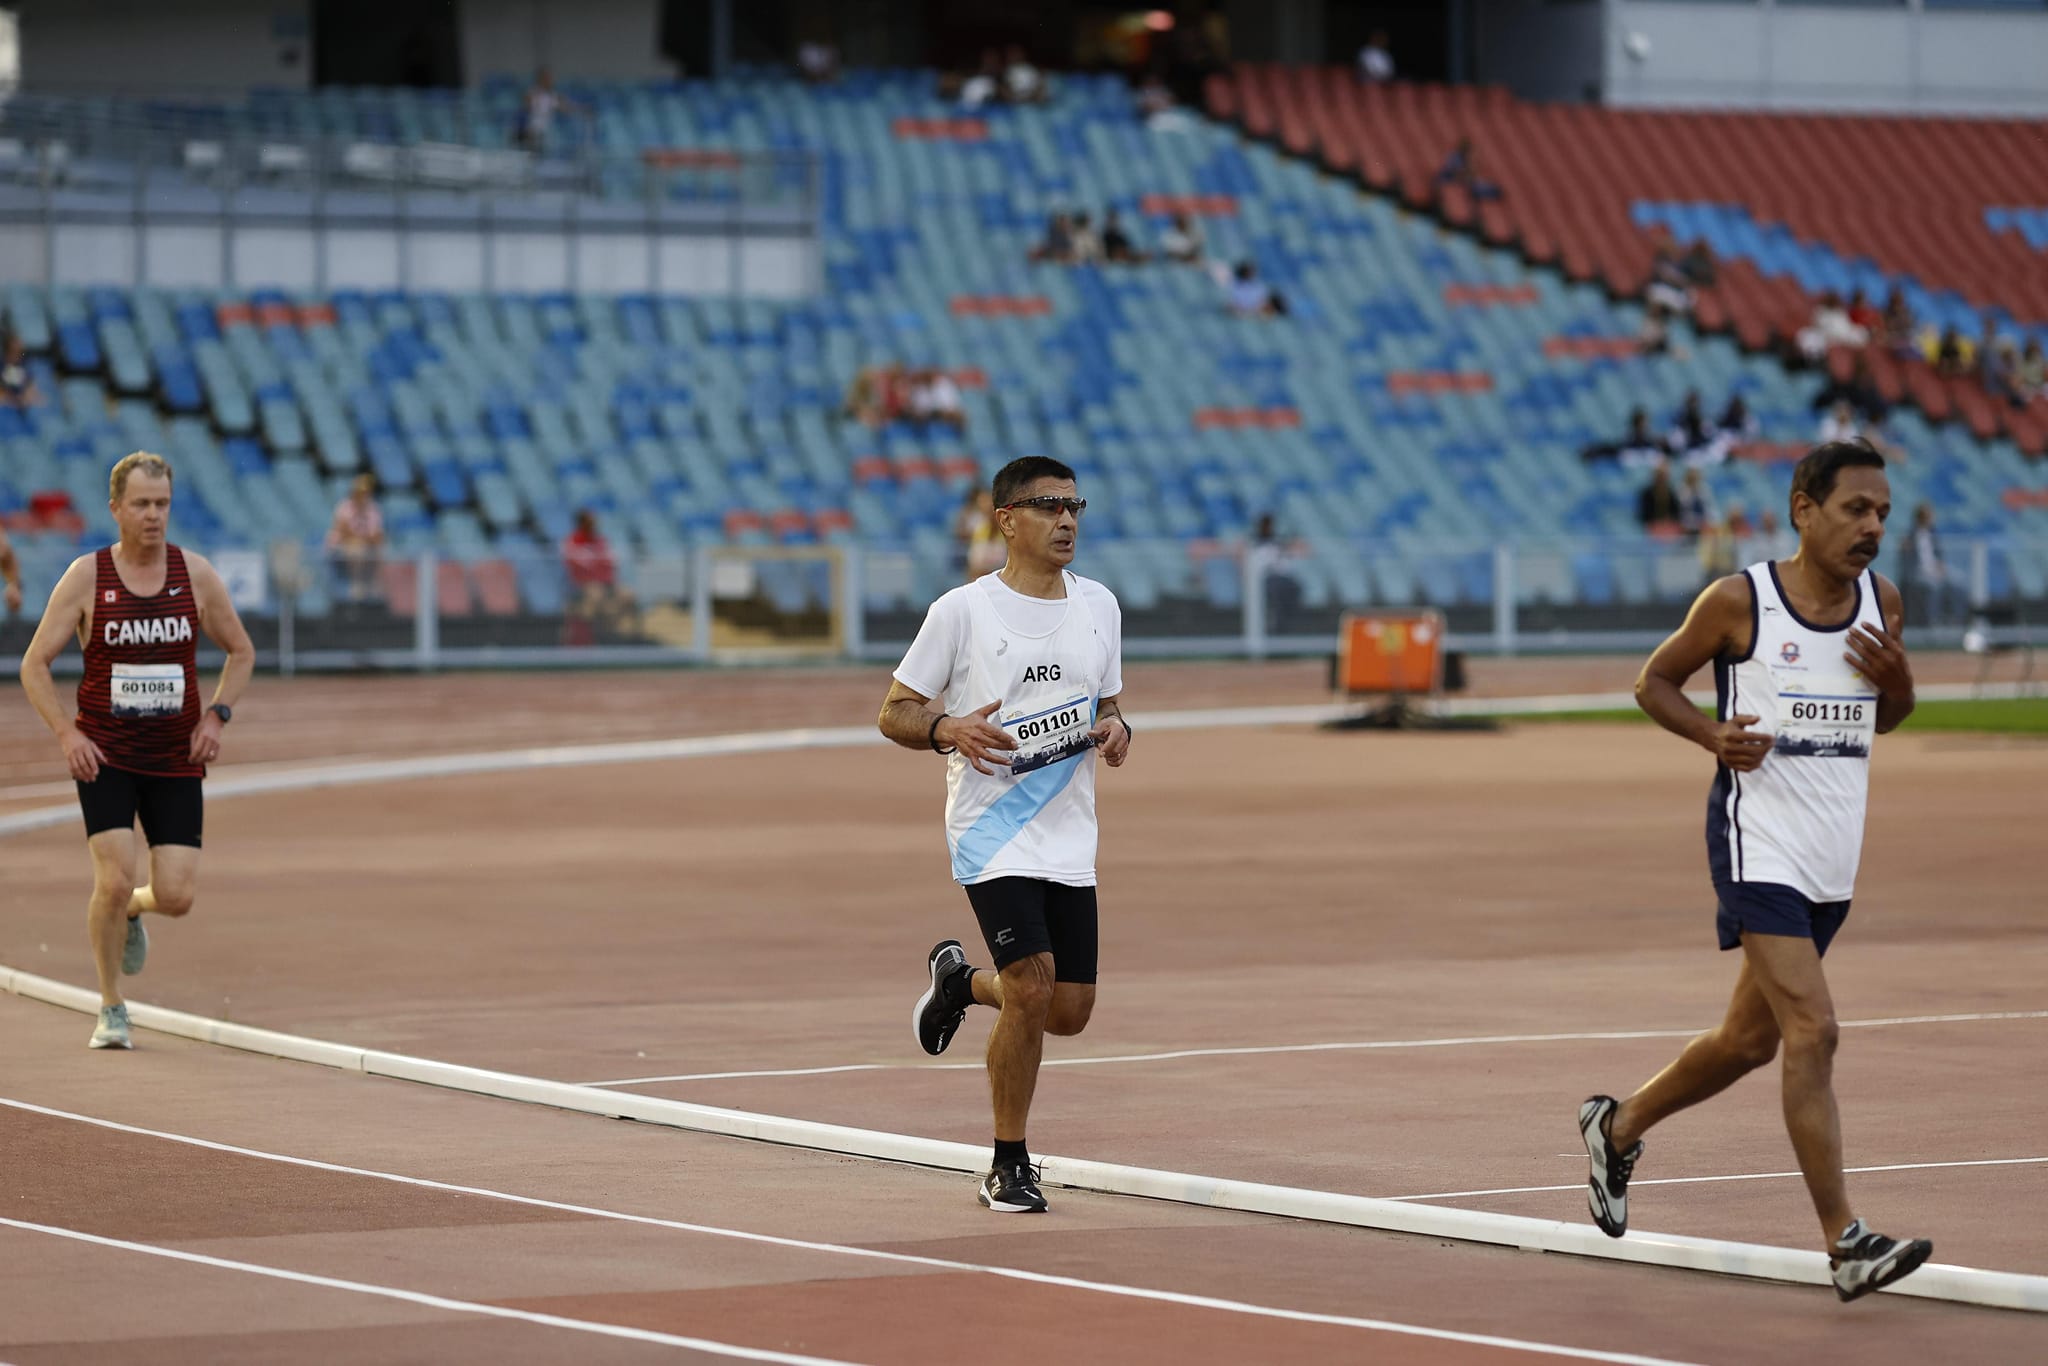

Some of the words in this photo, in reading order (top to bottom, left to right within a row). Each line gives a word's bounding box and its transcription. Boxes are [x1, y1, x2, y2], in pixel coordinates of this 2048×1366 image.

[104, 616, 193, 646] CANADA
[1022, 664, 1062, 683] ARG
[121, 681, 175, 694] 601084
[1792, 702, 1864, 722] 601116
[1017, 708, 1081, 740] 601101
